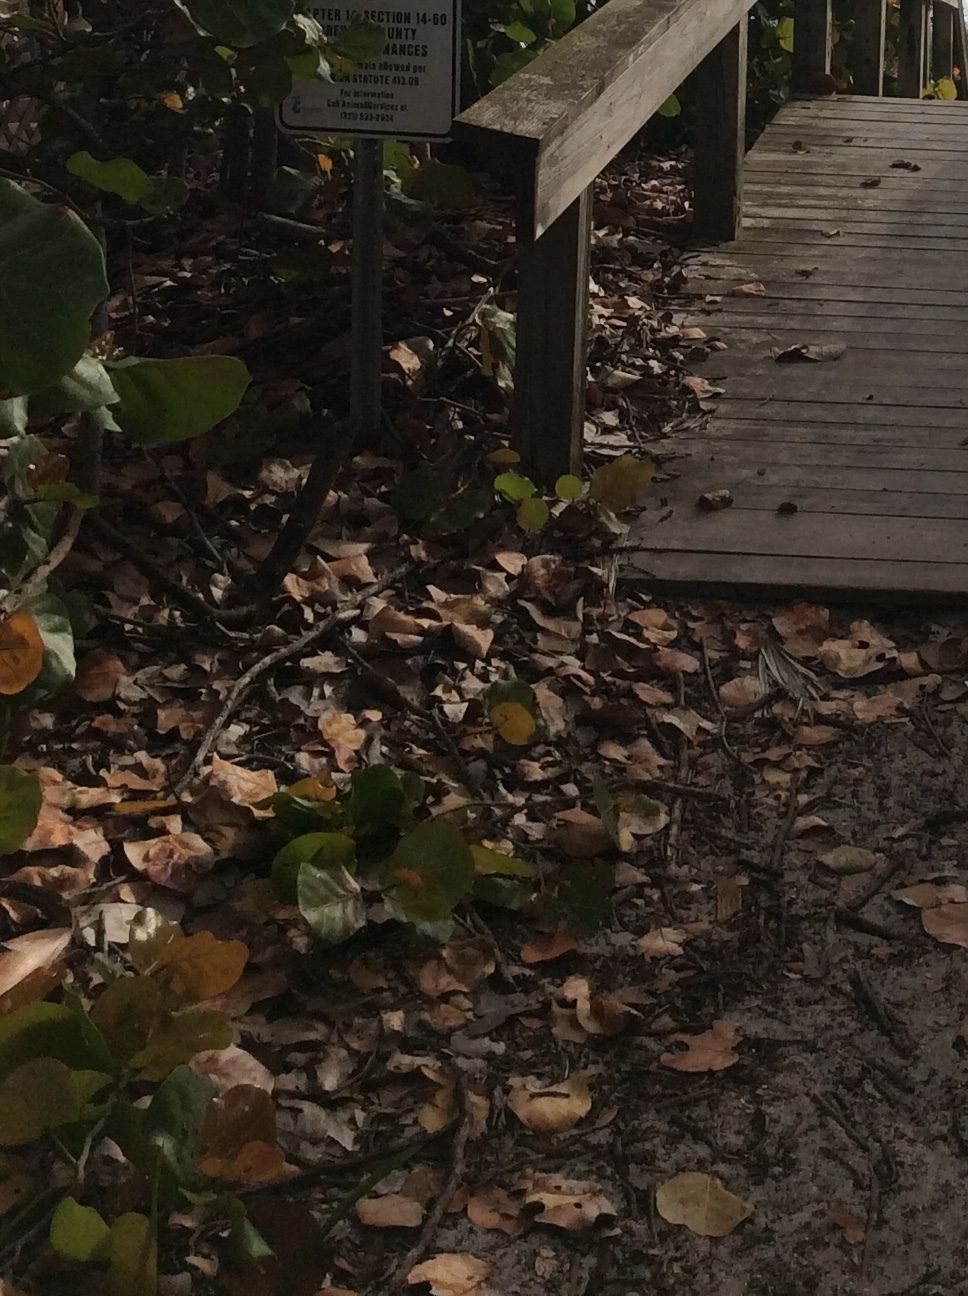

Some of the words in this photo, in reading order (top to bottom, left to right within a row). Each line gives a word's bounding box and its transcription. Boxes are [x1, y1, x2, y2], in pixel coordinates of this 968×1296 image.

[365, 10, 411, 24] SECTION
[415, 12, 447, 26] 14-60
[388, 28, 417, 41] UNTY
[384, 44, 428, 57] NANCES
[352, 74, 389, 86] STATUTE
